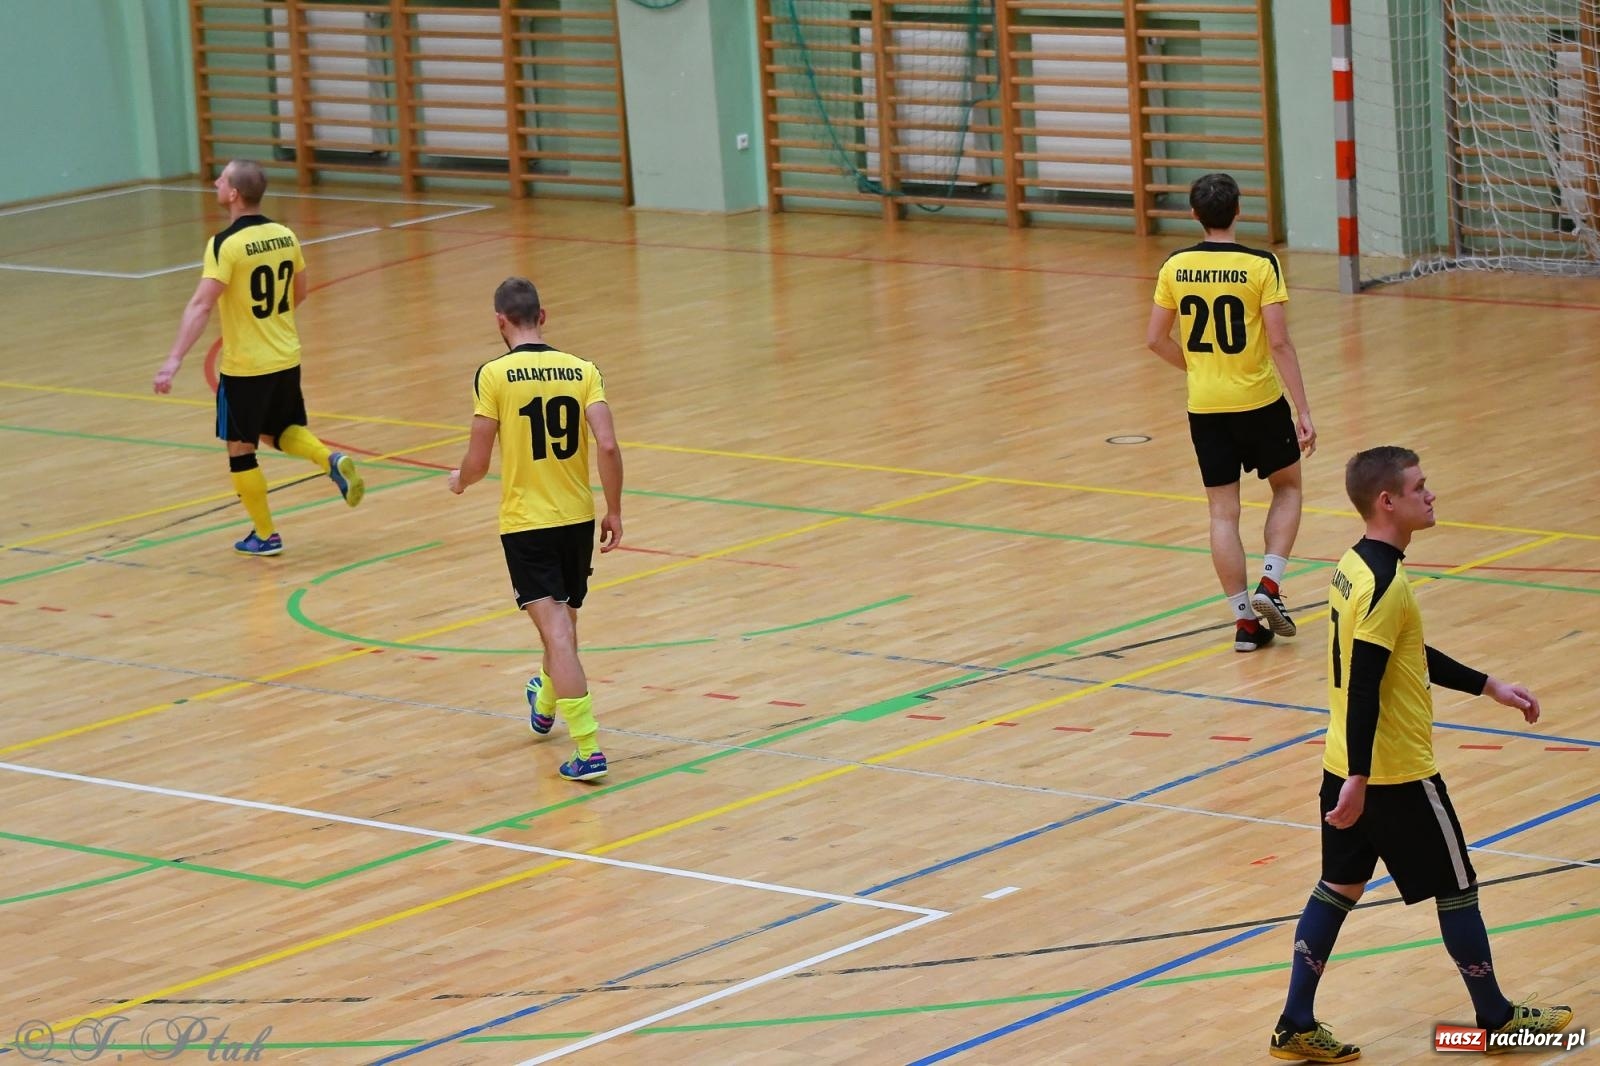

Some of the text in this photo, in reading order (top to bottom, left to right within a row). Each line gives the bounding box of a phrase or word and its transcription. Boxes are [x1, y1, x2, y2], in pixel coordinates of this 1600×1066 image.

[245, 236, 294, 256] GALAKTIKOS
[250, 260, 294, 319] 92
[1176, 269, 1248, 284] GALAKTIKOS
[1180, 294, 1247, 355] 20
[506, 367, 583, 383] GALAKTIKOS
[518, 395, 581, 461] 19
